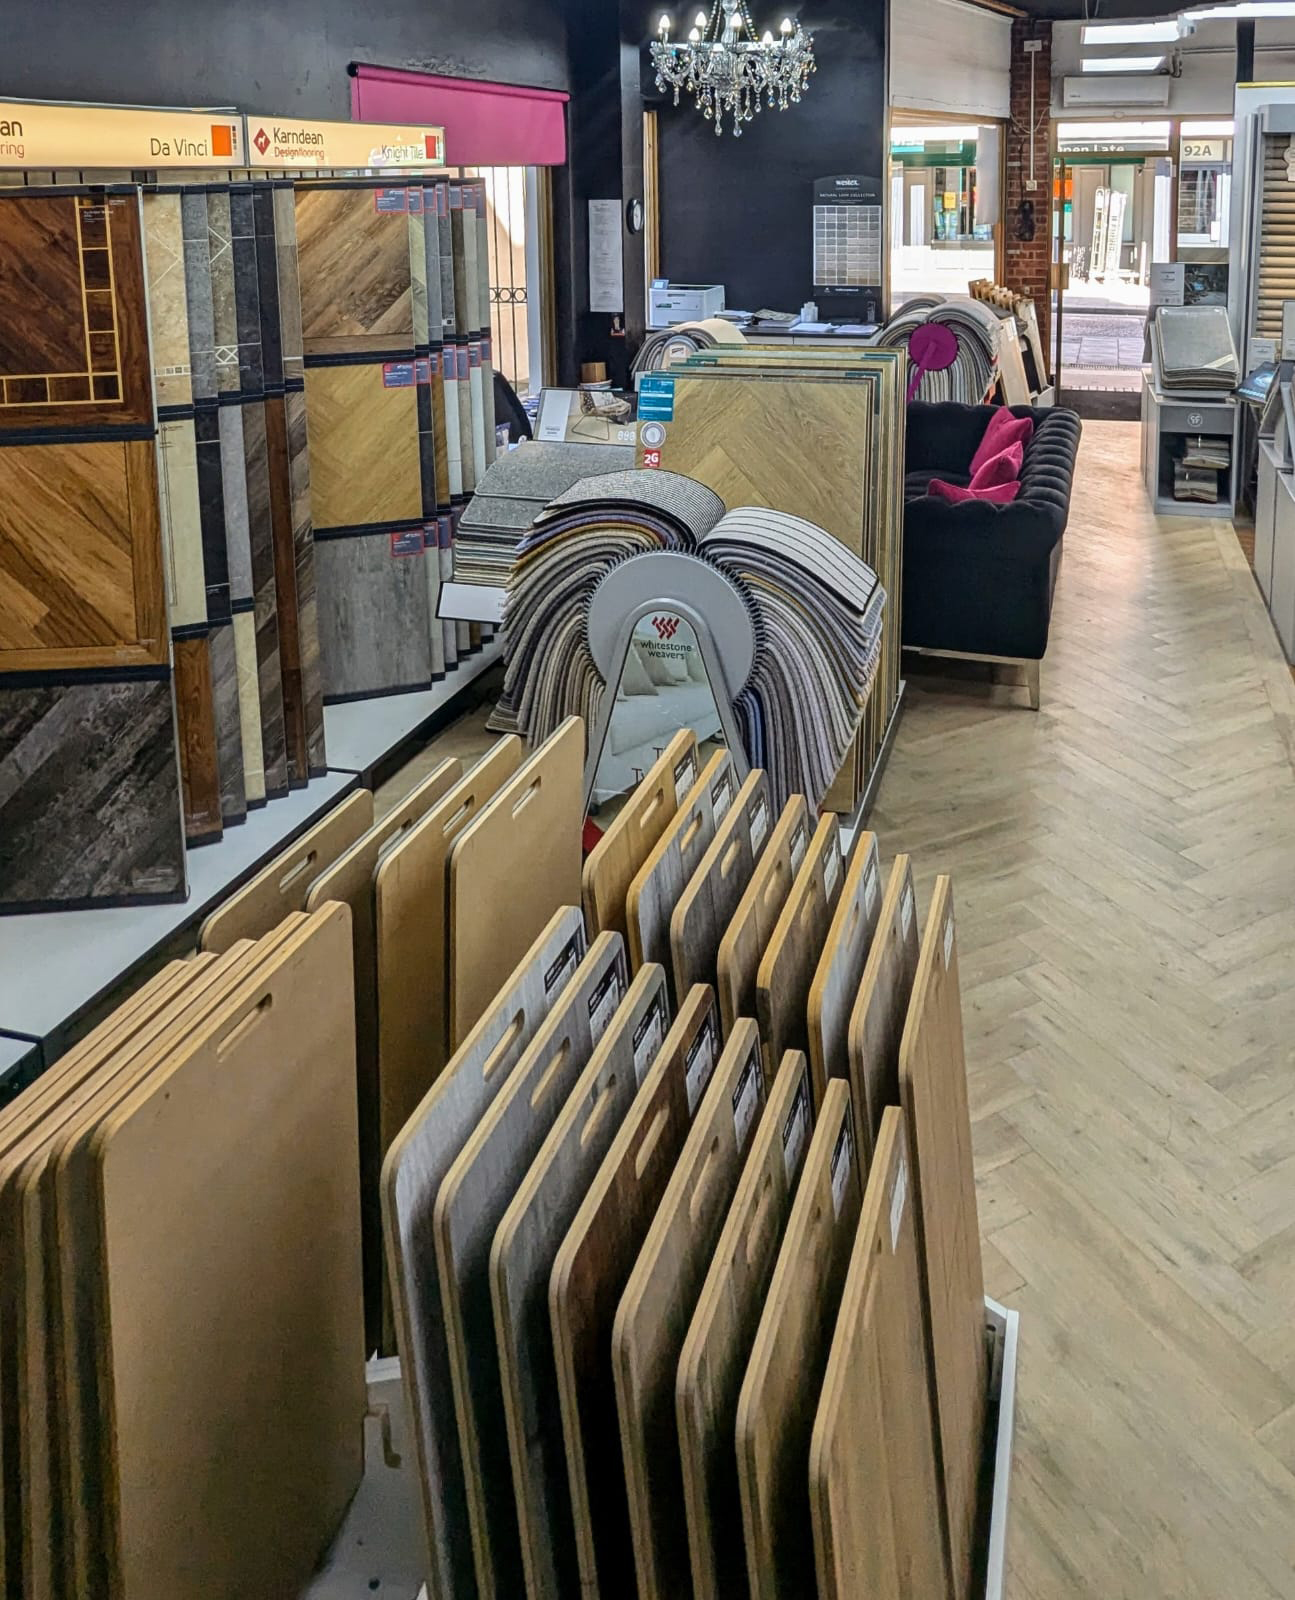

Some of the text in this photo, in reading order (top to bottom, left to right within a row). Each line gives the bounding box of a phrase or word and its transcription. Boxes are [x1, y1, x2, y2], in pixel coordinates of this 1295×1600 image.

[273, 127, 324, 145] Karndean
[150, 137, 208, 156] Da Vinci
[381, 144, 424, 162] Knight Tile
[1184, 144, 1212, 157] 92A
[643, 452, 660, 465] 2G
[640, 640, 692, 652] whitestone
[648, 650, 685, 661] weavers
